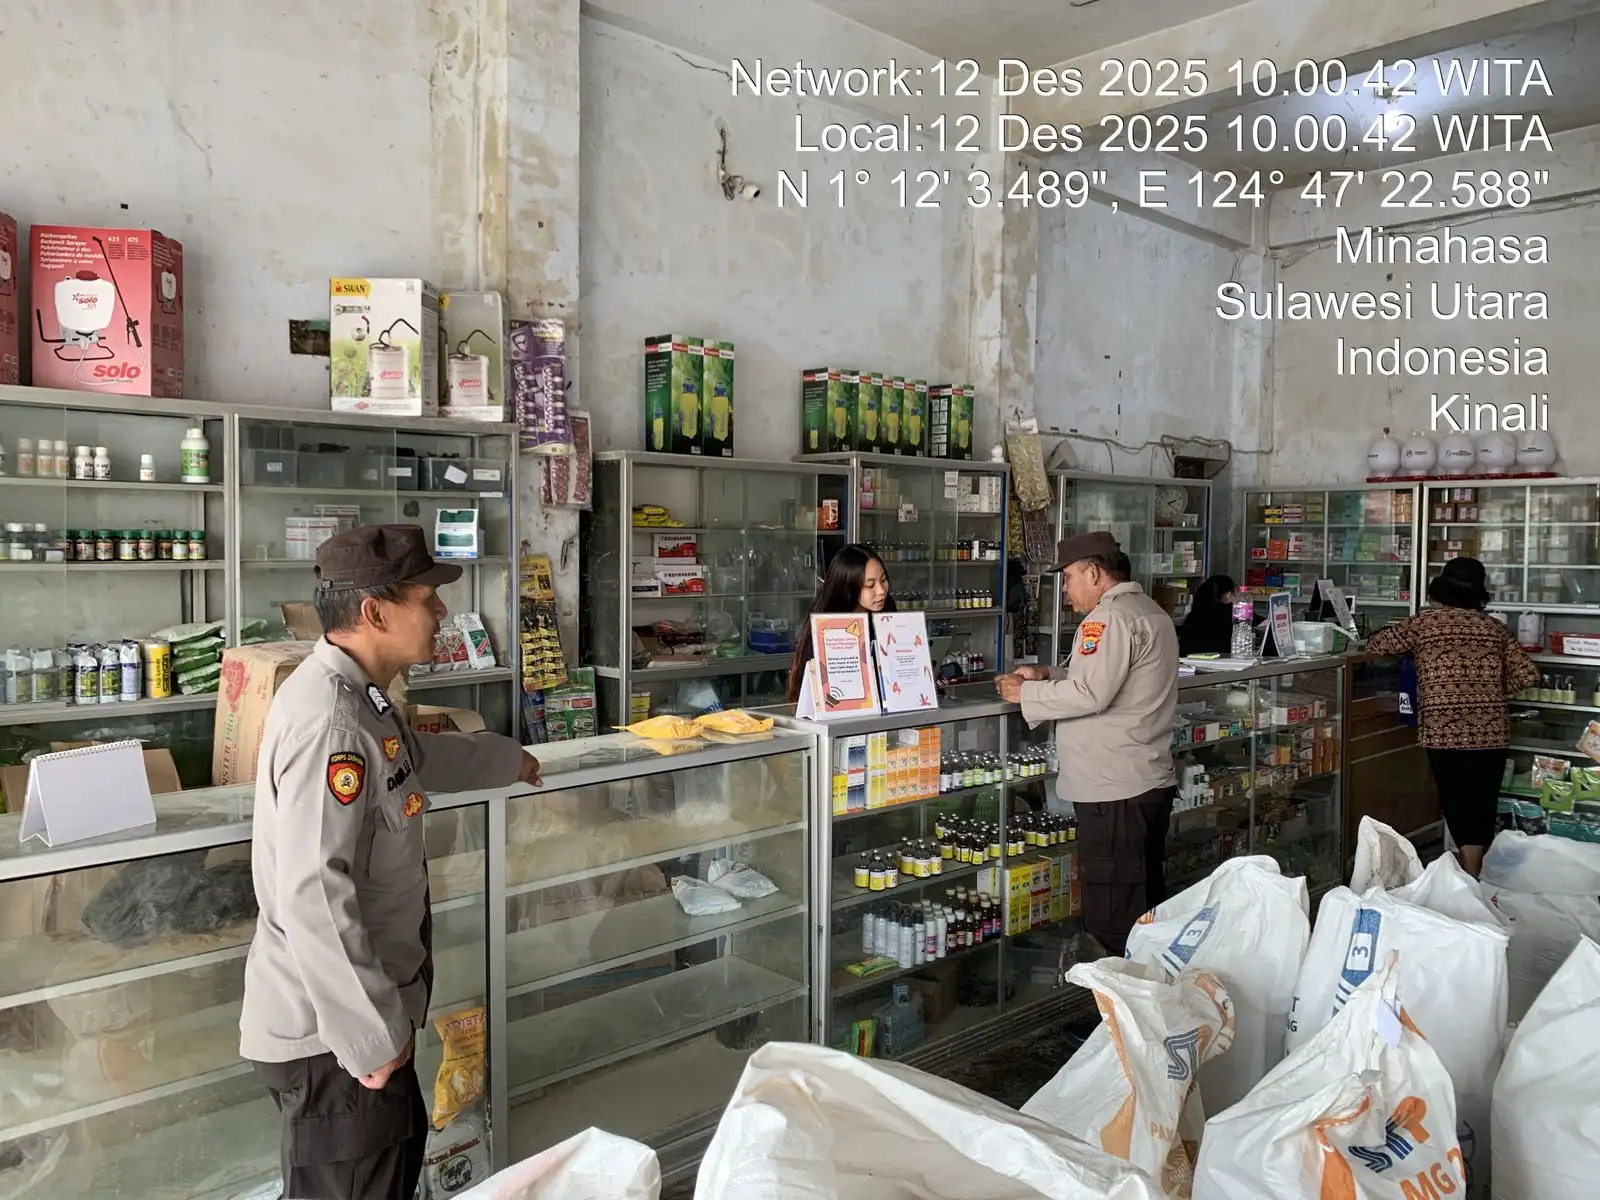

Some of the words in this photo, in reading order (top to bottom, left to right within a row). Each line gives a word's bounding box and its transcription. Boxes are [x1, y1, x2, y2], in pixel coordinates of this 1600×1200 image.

[343, 284, 366, 294] SWAN
[78, 296, 98, 304] solo
[93, 362, 141, 379] solo
[1352, 946, 1369, 958] 3
